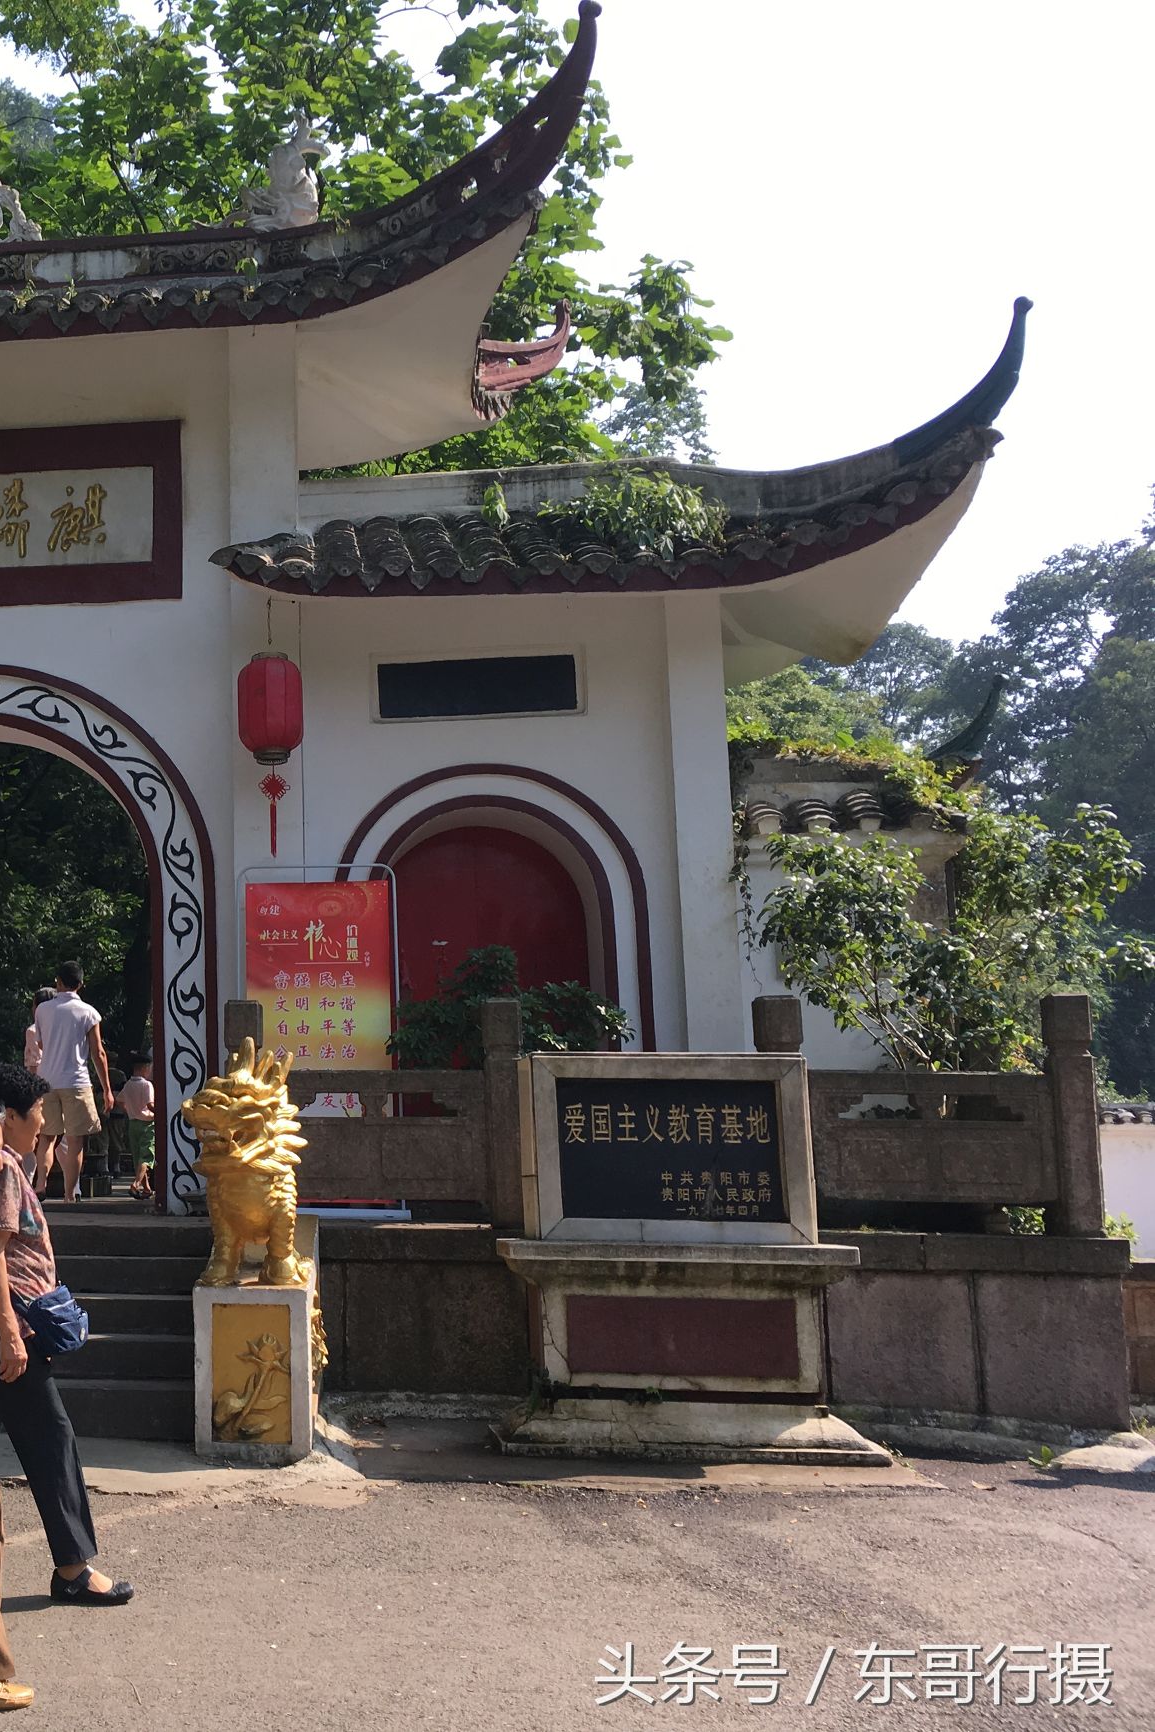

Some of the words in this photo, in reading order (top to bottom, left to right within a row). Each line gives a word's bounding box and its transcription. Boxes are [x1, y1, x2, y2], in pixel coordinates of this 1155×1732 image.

[303, 918, 343, 961] 核心
[346, 924, 359, 962] 价值观
[563, 1102, 771, 1145] 爱国主义教育基地
[661, 1170, 771, 1187] 中共贵阳市委
[661, 1186, 772, 1203] 贵阳市人民政府
[676, 1204, 760, 1217] 一九七年四月
